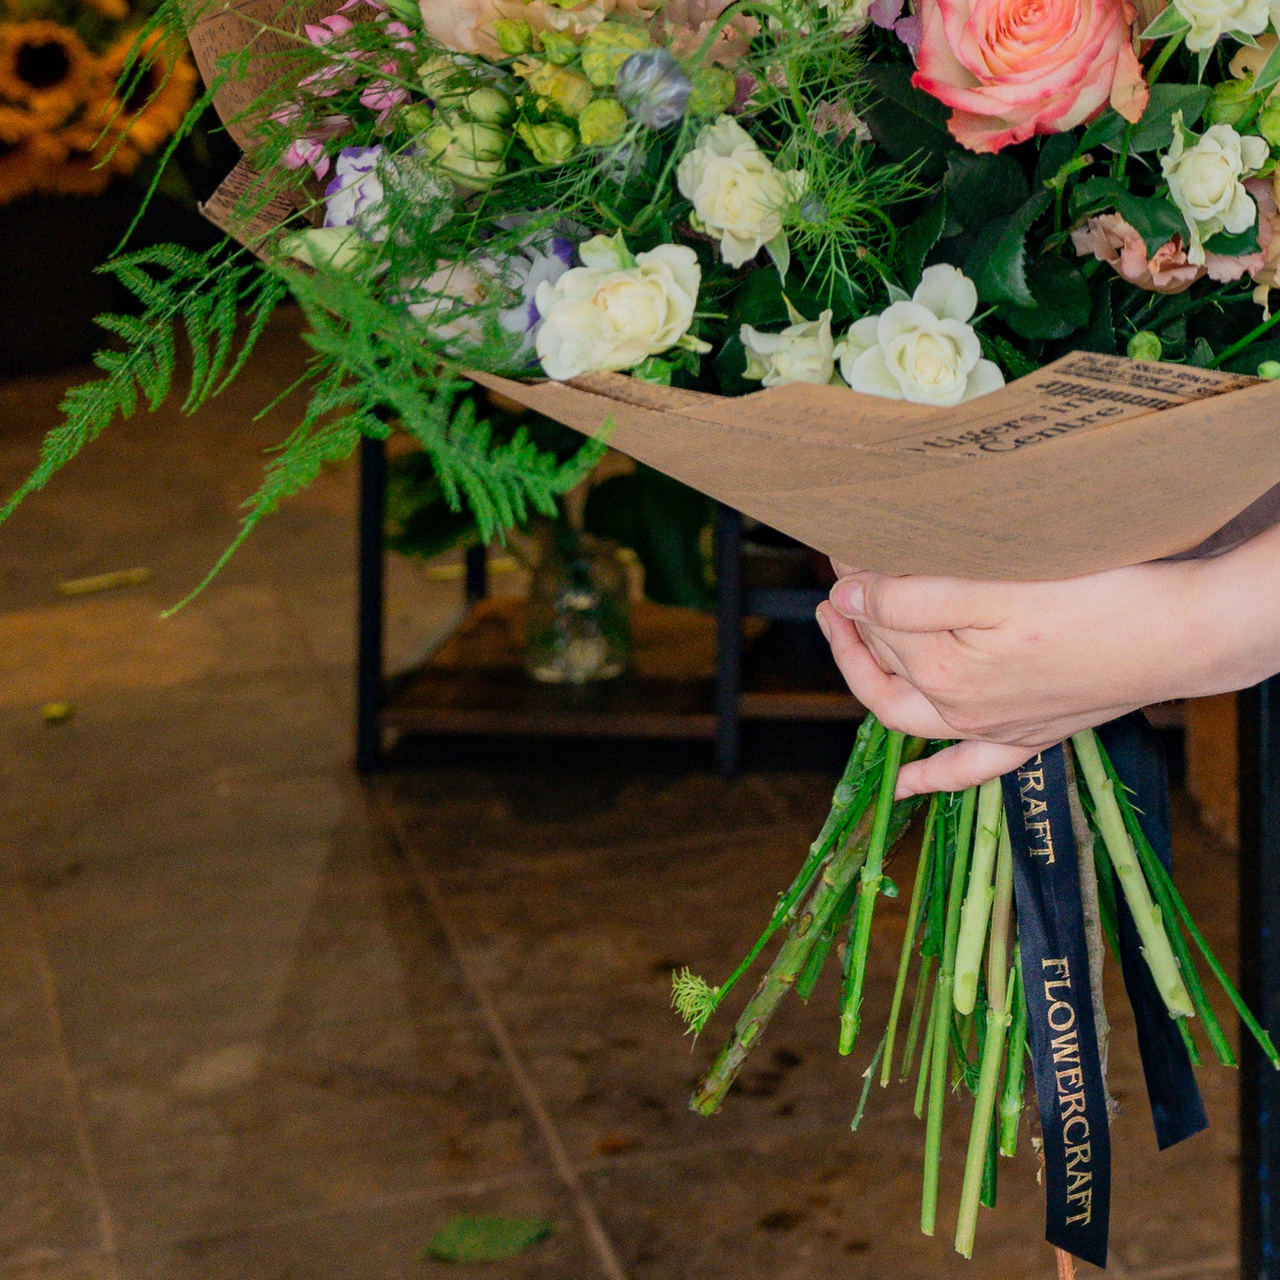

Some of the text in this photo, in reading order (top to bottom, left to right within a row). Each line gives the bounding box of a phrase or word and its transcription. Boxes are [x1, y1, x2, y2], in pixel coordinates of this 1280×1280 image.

[923, 413, 1047, 447] tigers
[979, 406, 1124, 453] Centre
[1041, 956, 1091, 1228] FLOWERCRAFT
